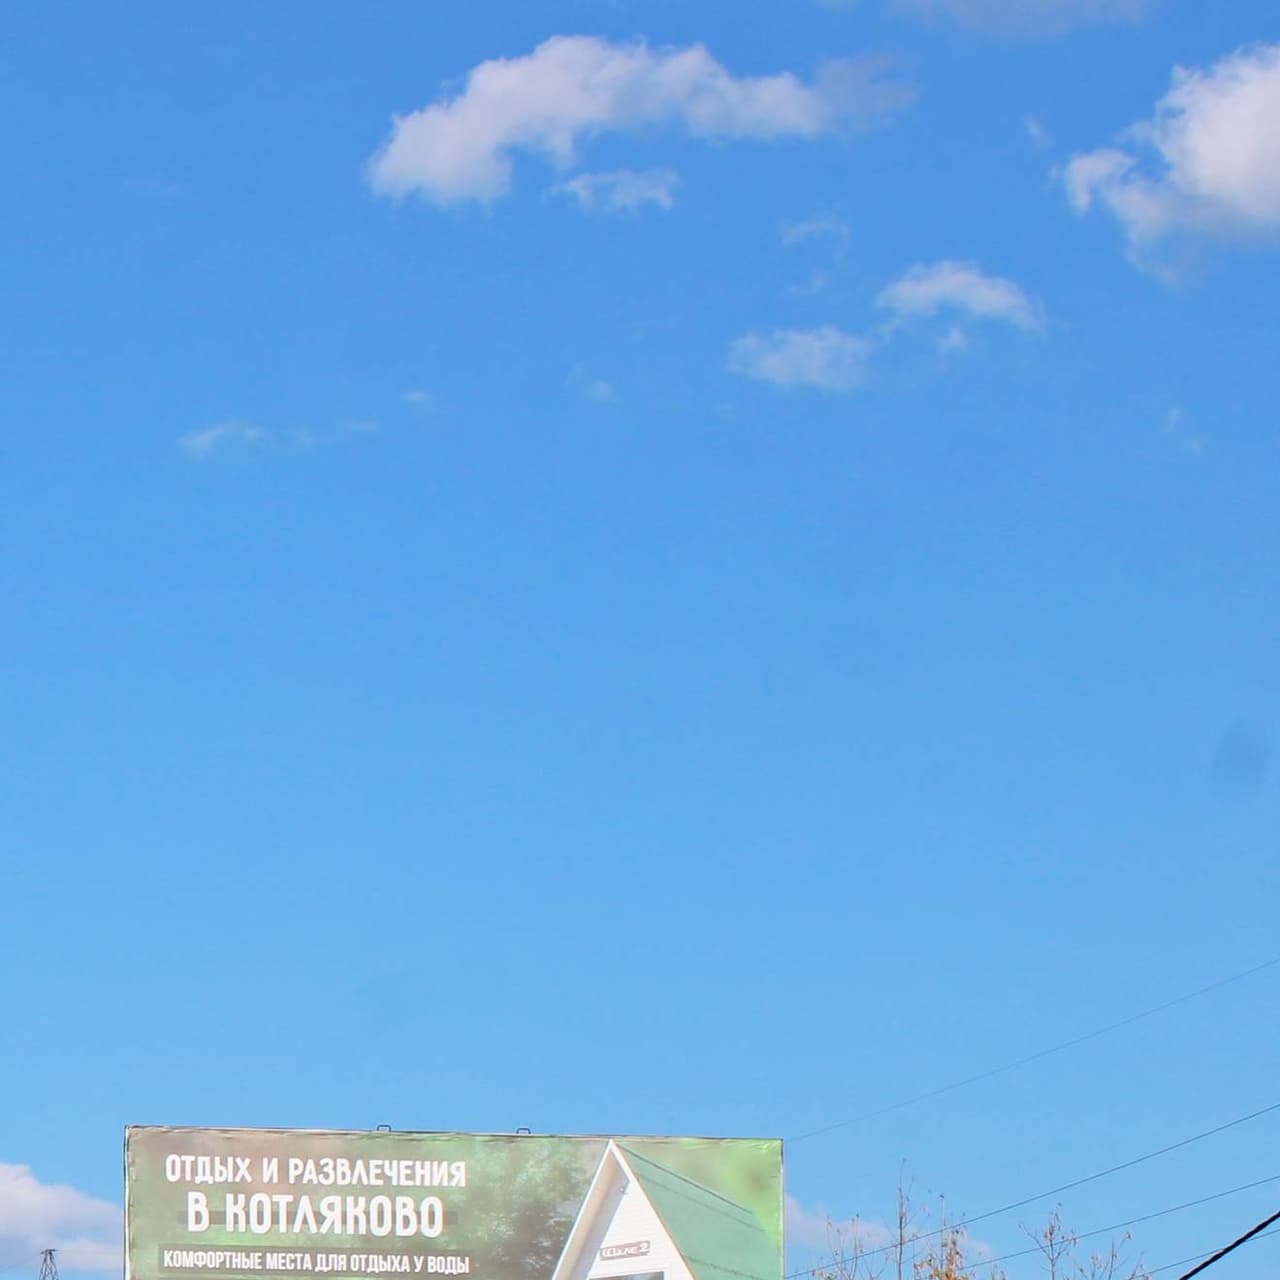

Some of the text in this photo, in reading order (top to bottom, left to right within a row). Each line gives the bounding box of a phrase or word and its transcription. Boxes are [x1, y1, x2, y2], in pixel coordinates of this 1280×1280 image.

[165, 1154, 466, 1187] ОТДЫХ И РАЗВЛЕЧЕНИЯ
[187, 1191, 443, 1238] В КОТЛЯКОВО
[163, 1250, 470, 1275] КОМФОРТНЫЕ МЕСТА ДЛЯ ОТДЫХА У ВОДЫ
